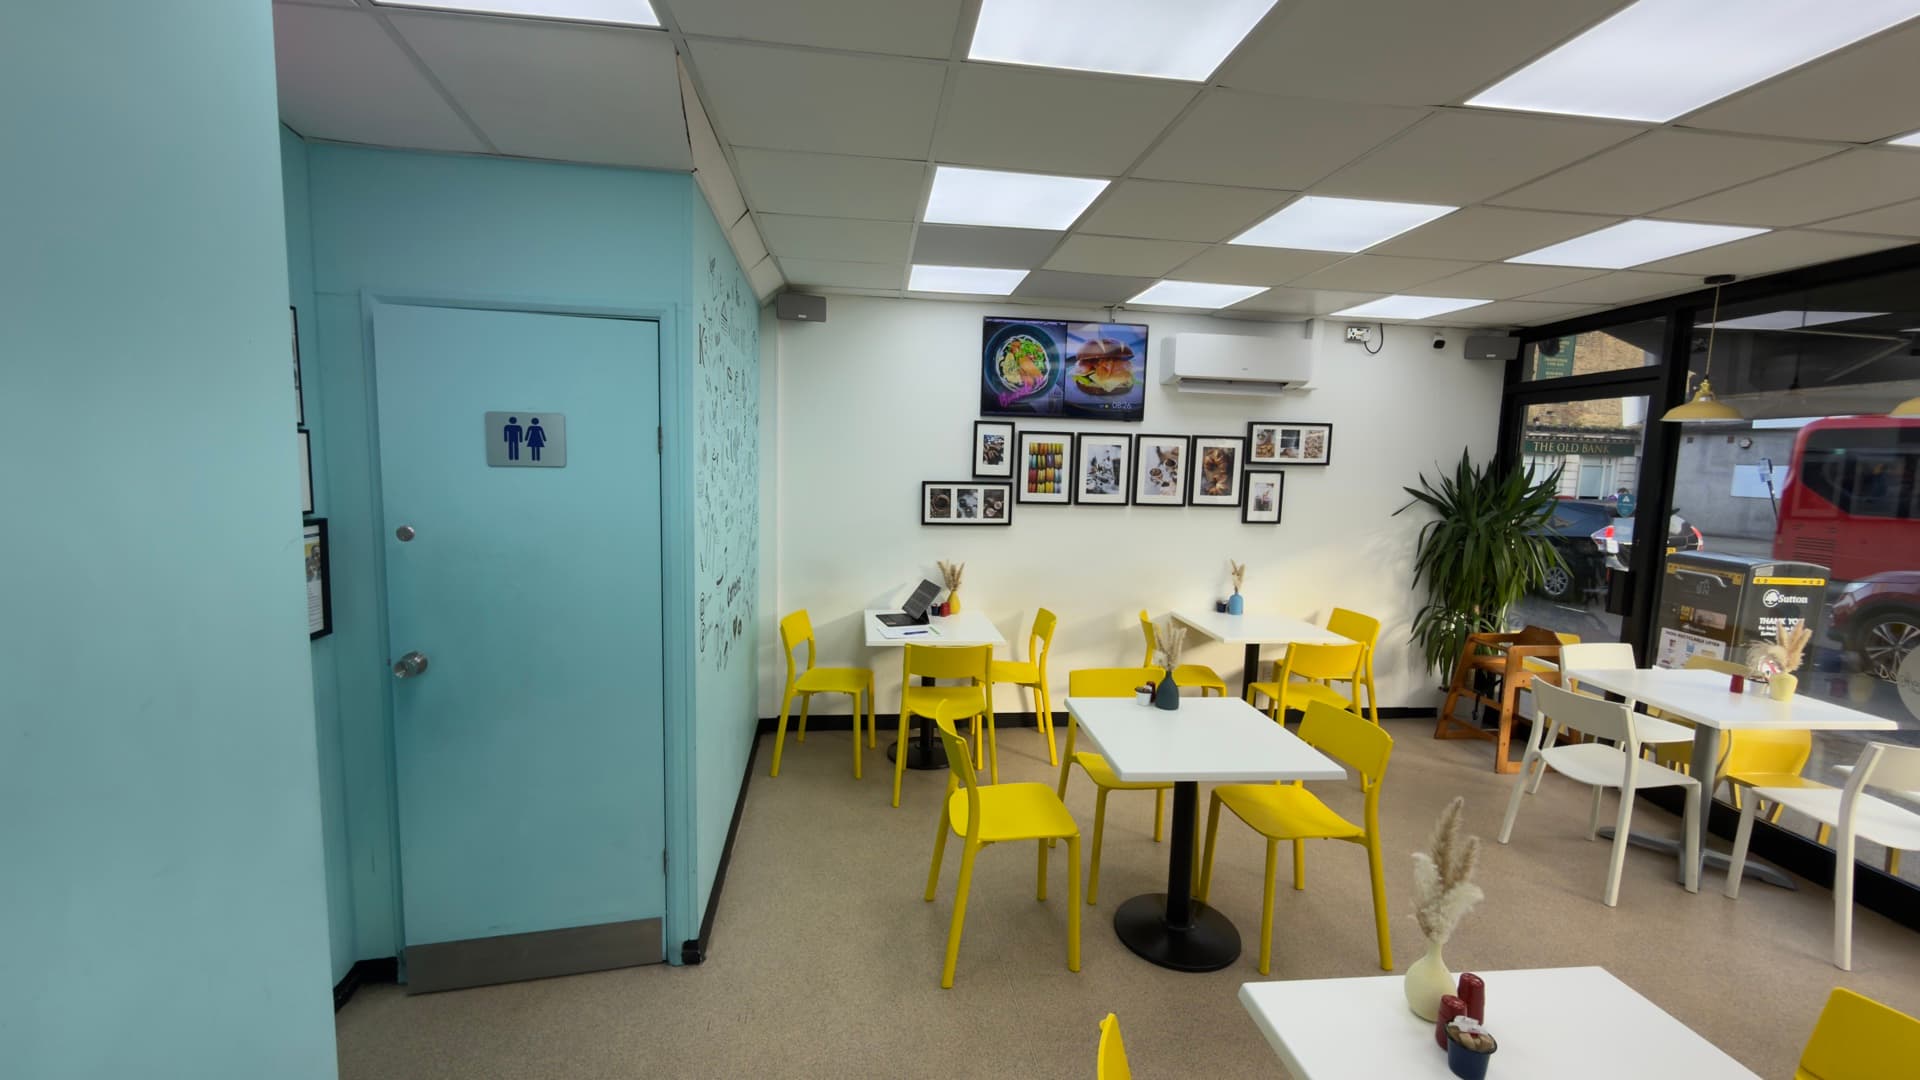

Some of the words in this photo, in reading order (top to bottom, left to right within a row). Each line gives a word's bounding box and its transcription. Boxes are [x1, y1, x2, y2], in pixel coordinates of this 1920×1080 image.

[1533, 441, 1553, 452] THE
[1556, 442, 1579, 453] OLD
[1582, 443, 1609, 454] BANK
[1778, 594, 1808, 604] Sutton
